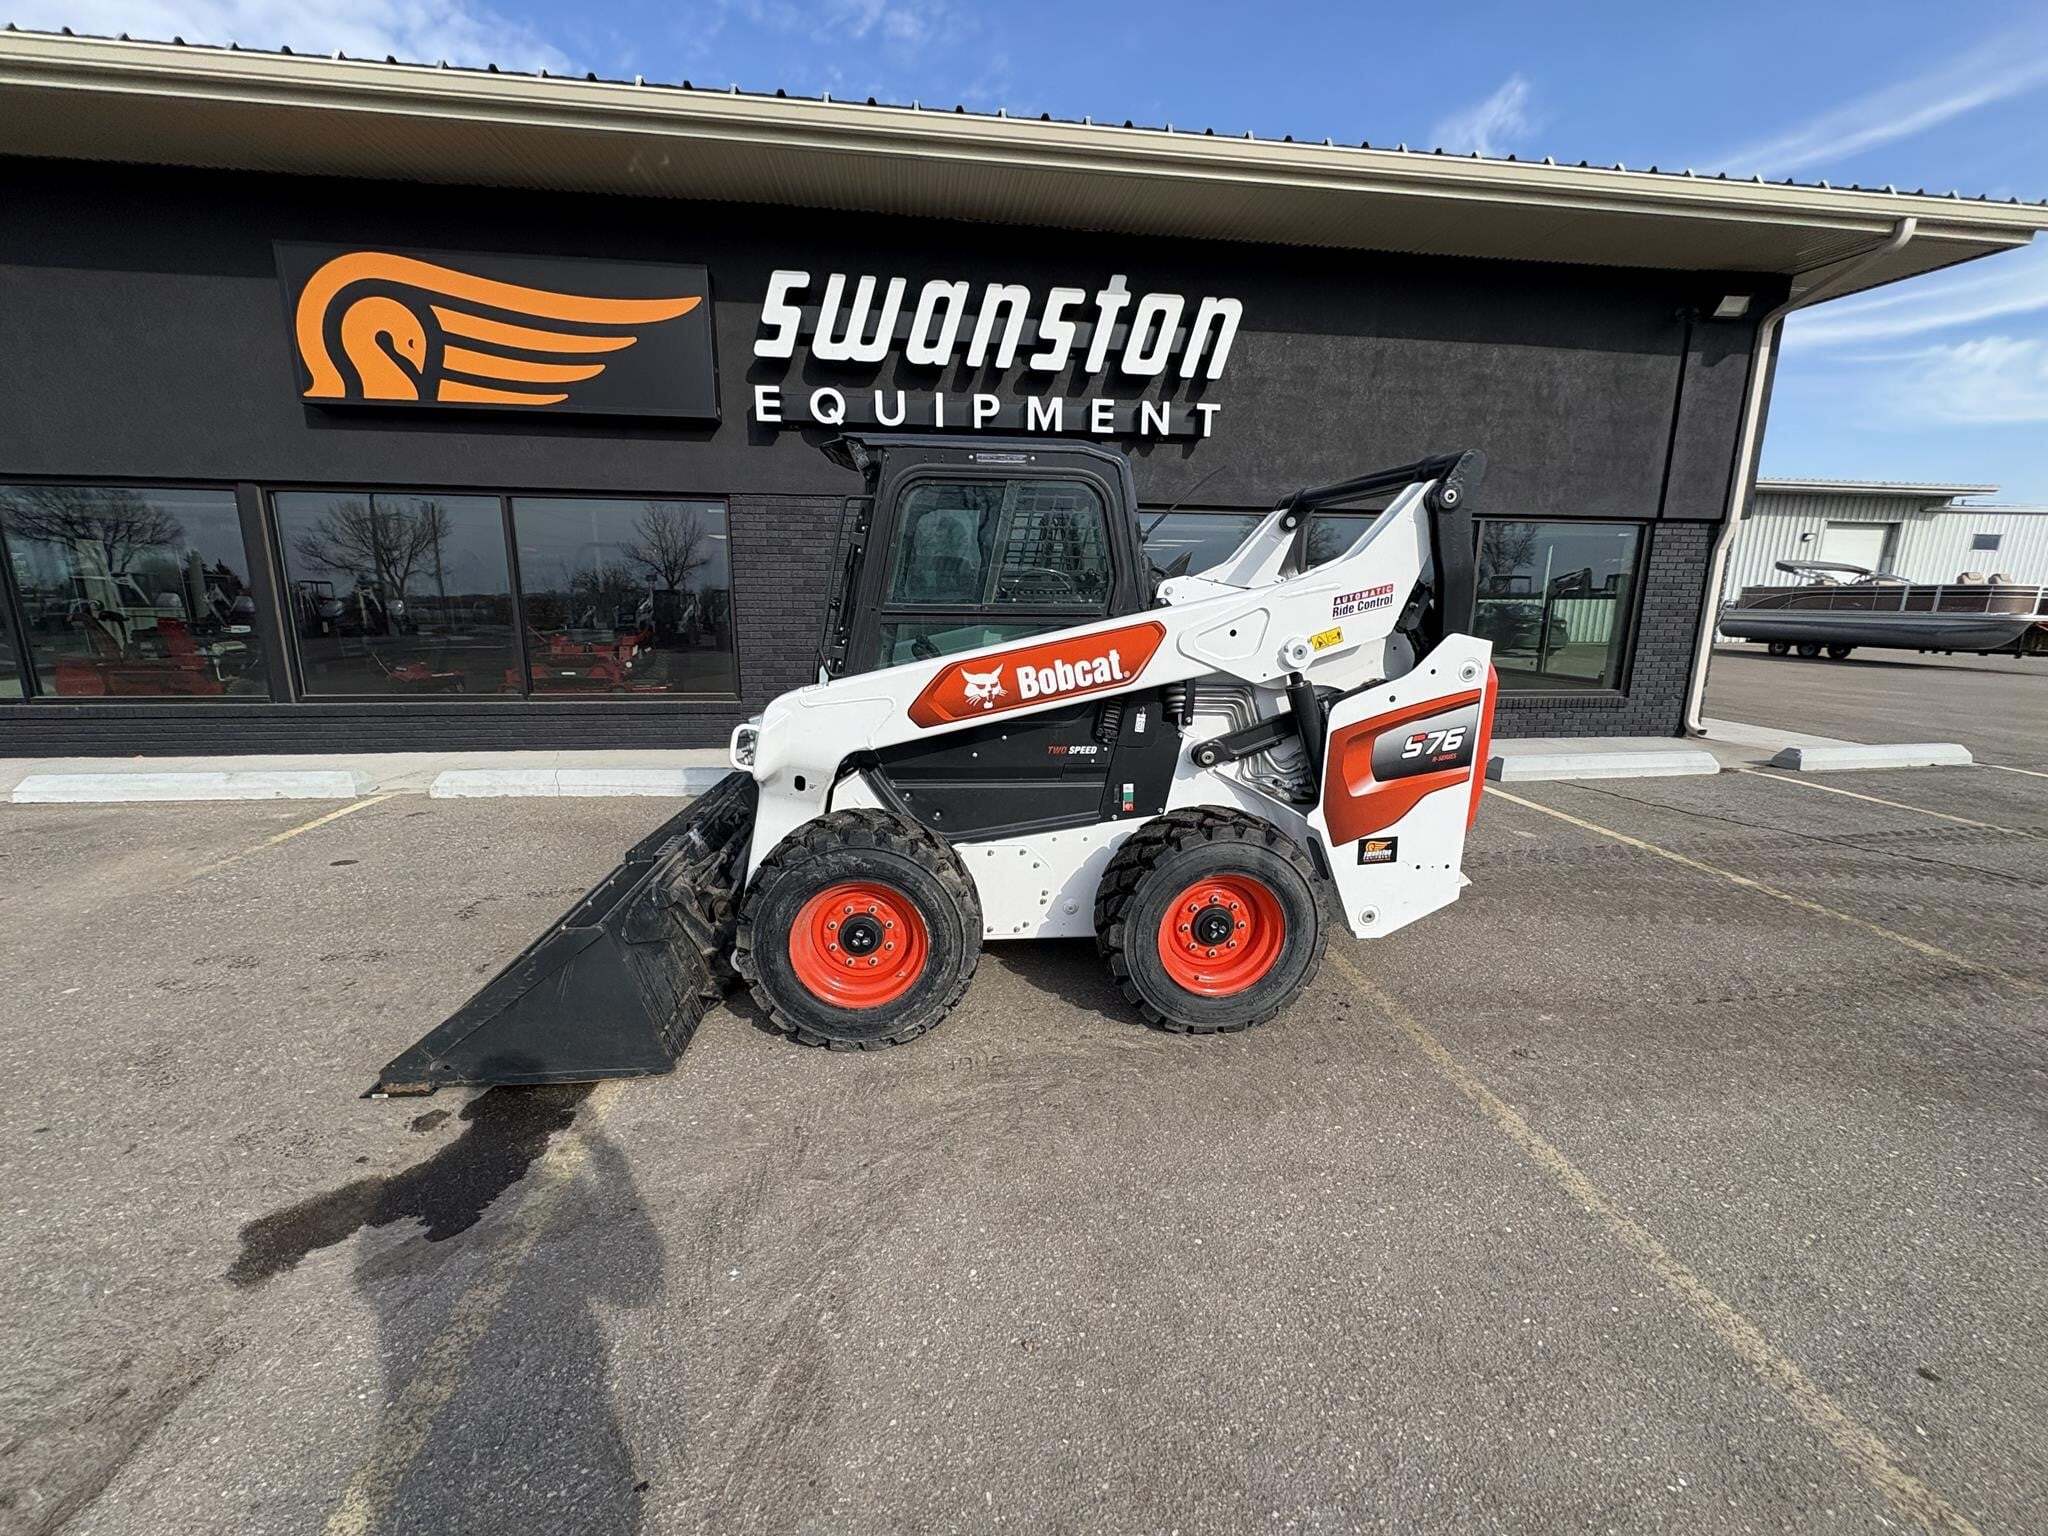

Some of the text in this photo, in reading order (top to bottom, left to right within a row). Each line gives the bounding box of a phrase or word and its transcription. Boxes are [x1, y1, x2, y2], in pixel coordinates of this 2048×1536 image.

[754, 384, 1221, 438] EQUIPMENT
[1332, 594, 1393, 617] Ride Control
[1334, 584, 1394, 606] AUTOMATIC
[1016, 649, 1123, 699] Bobcat
[1048, 745, 1098, 755] TWO SPEED
[1401, 726, 1467, 759] S76
